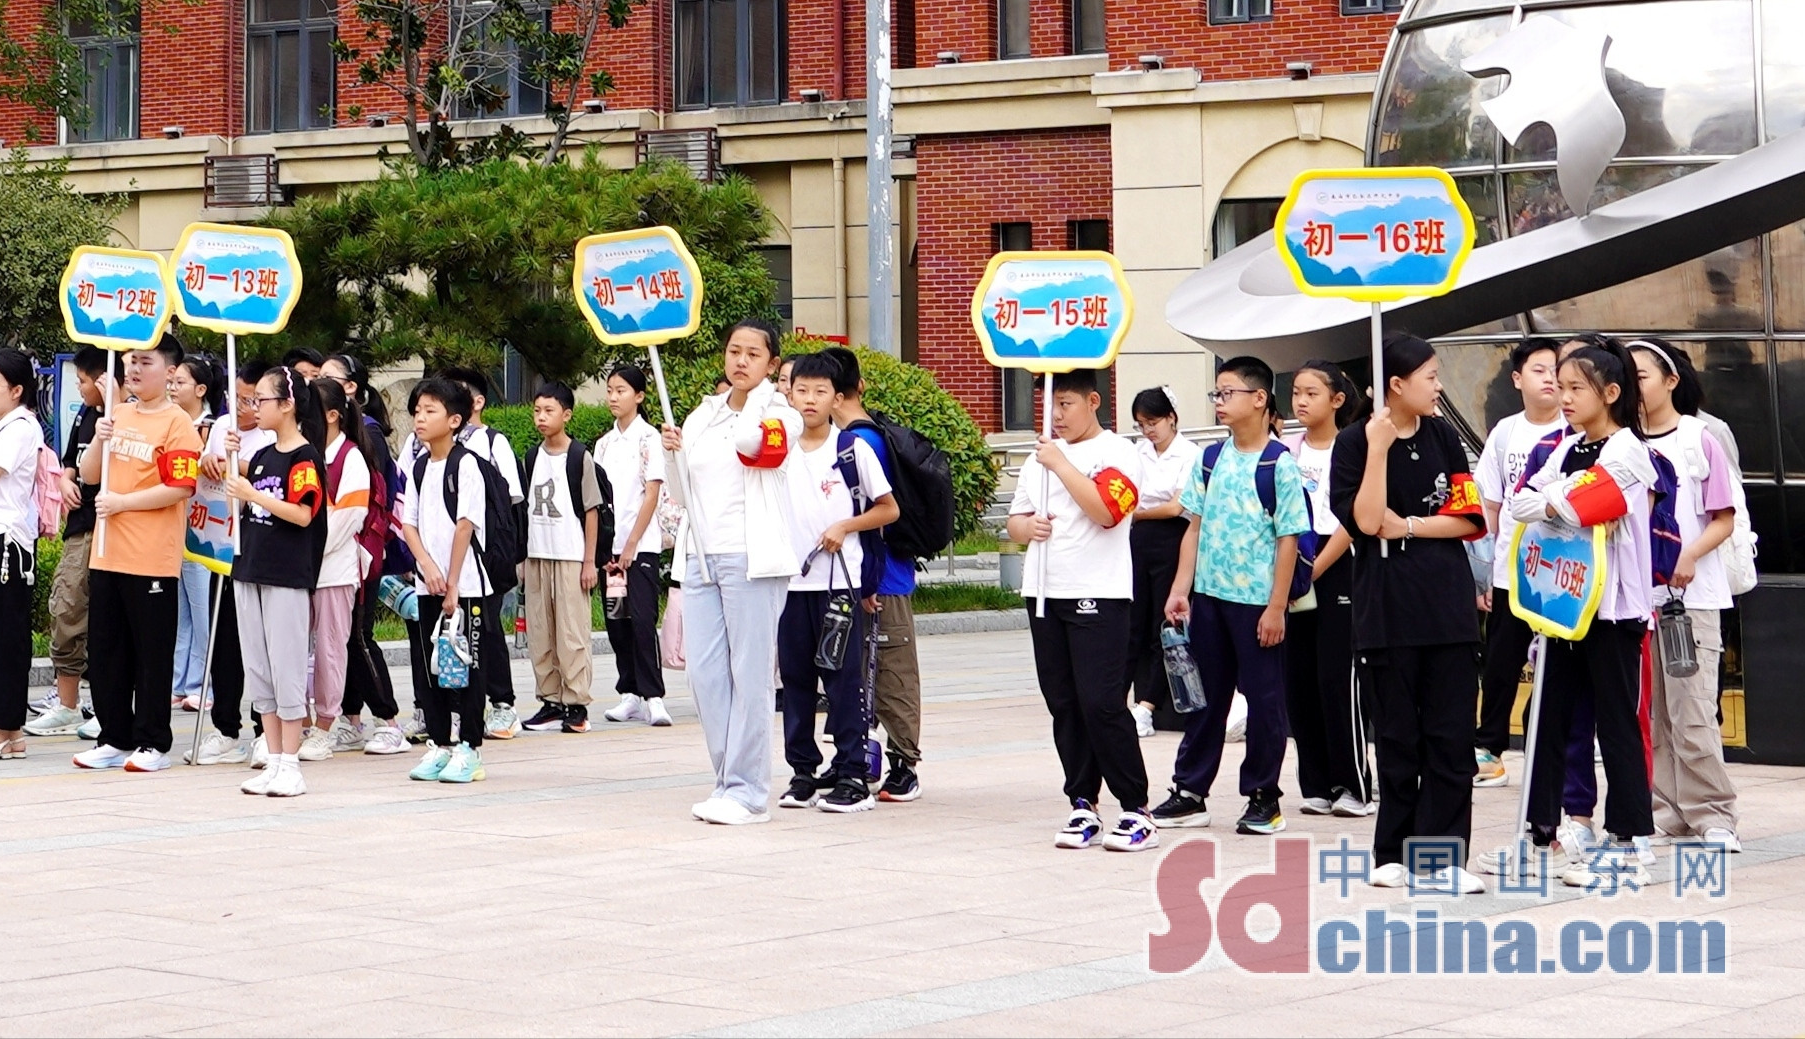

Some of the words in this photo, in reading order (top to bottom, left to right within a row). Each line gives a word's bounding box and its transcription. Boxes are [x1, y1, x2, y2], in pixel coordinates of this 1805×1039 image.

[1303, 218, 1446, 256] 初一16班
[77, 279, 157, 317] 初一12班
[185, 261, 279, 298] 初一13班
[593, 269, 685, 307] 初一14班
[994, 295, 1108, 330] 初一15班
[1525, 540, 1587, 598] 初一16班
